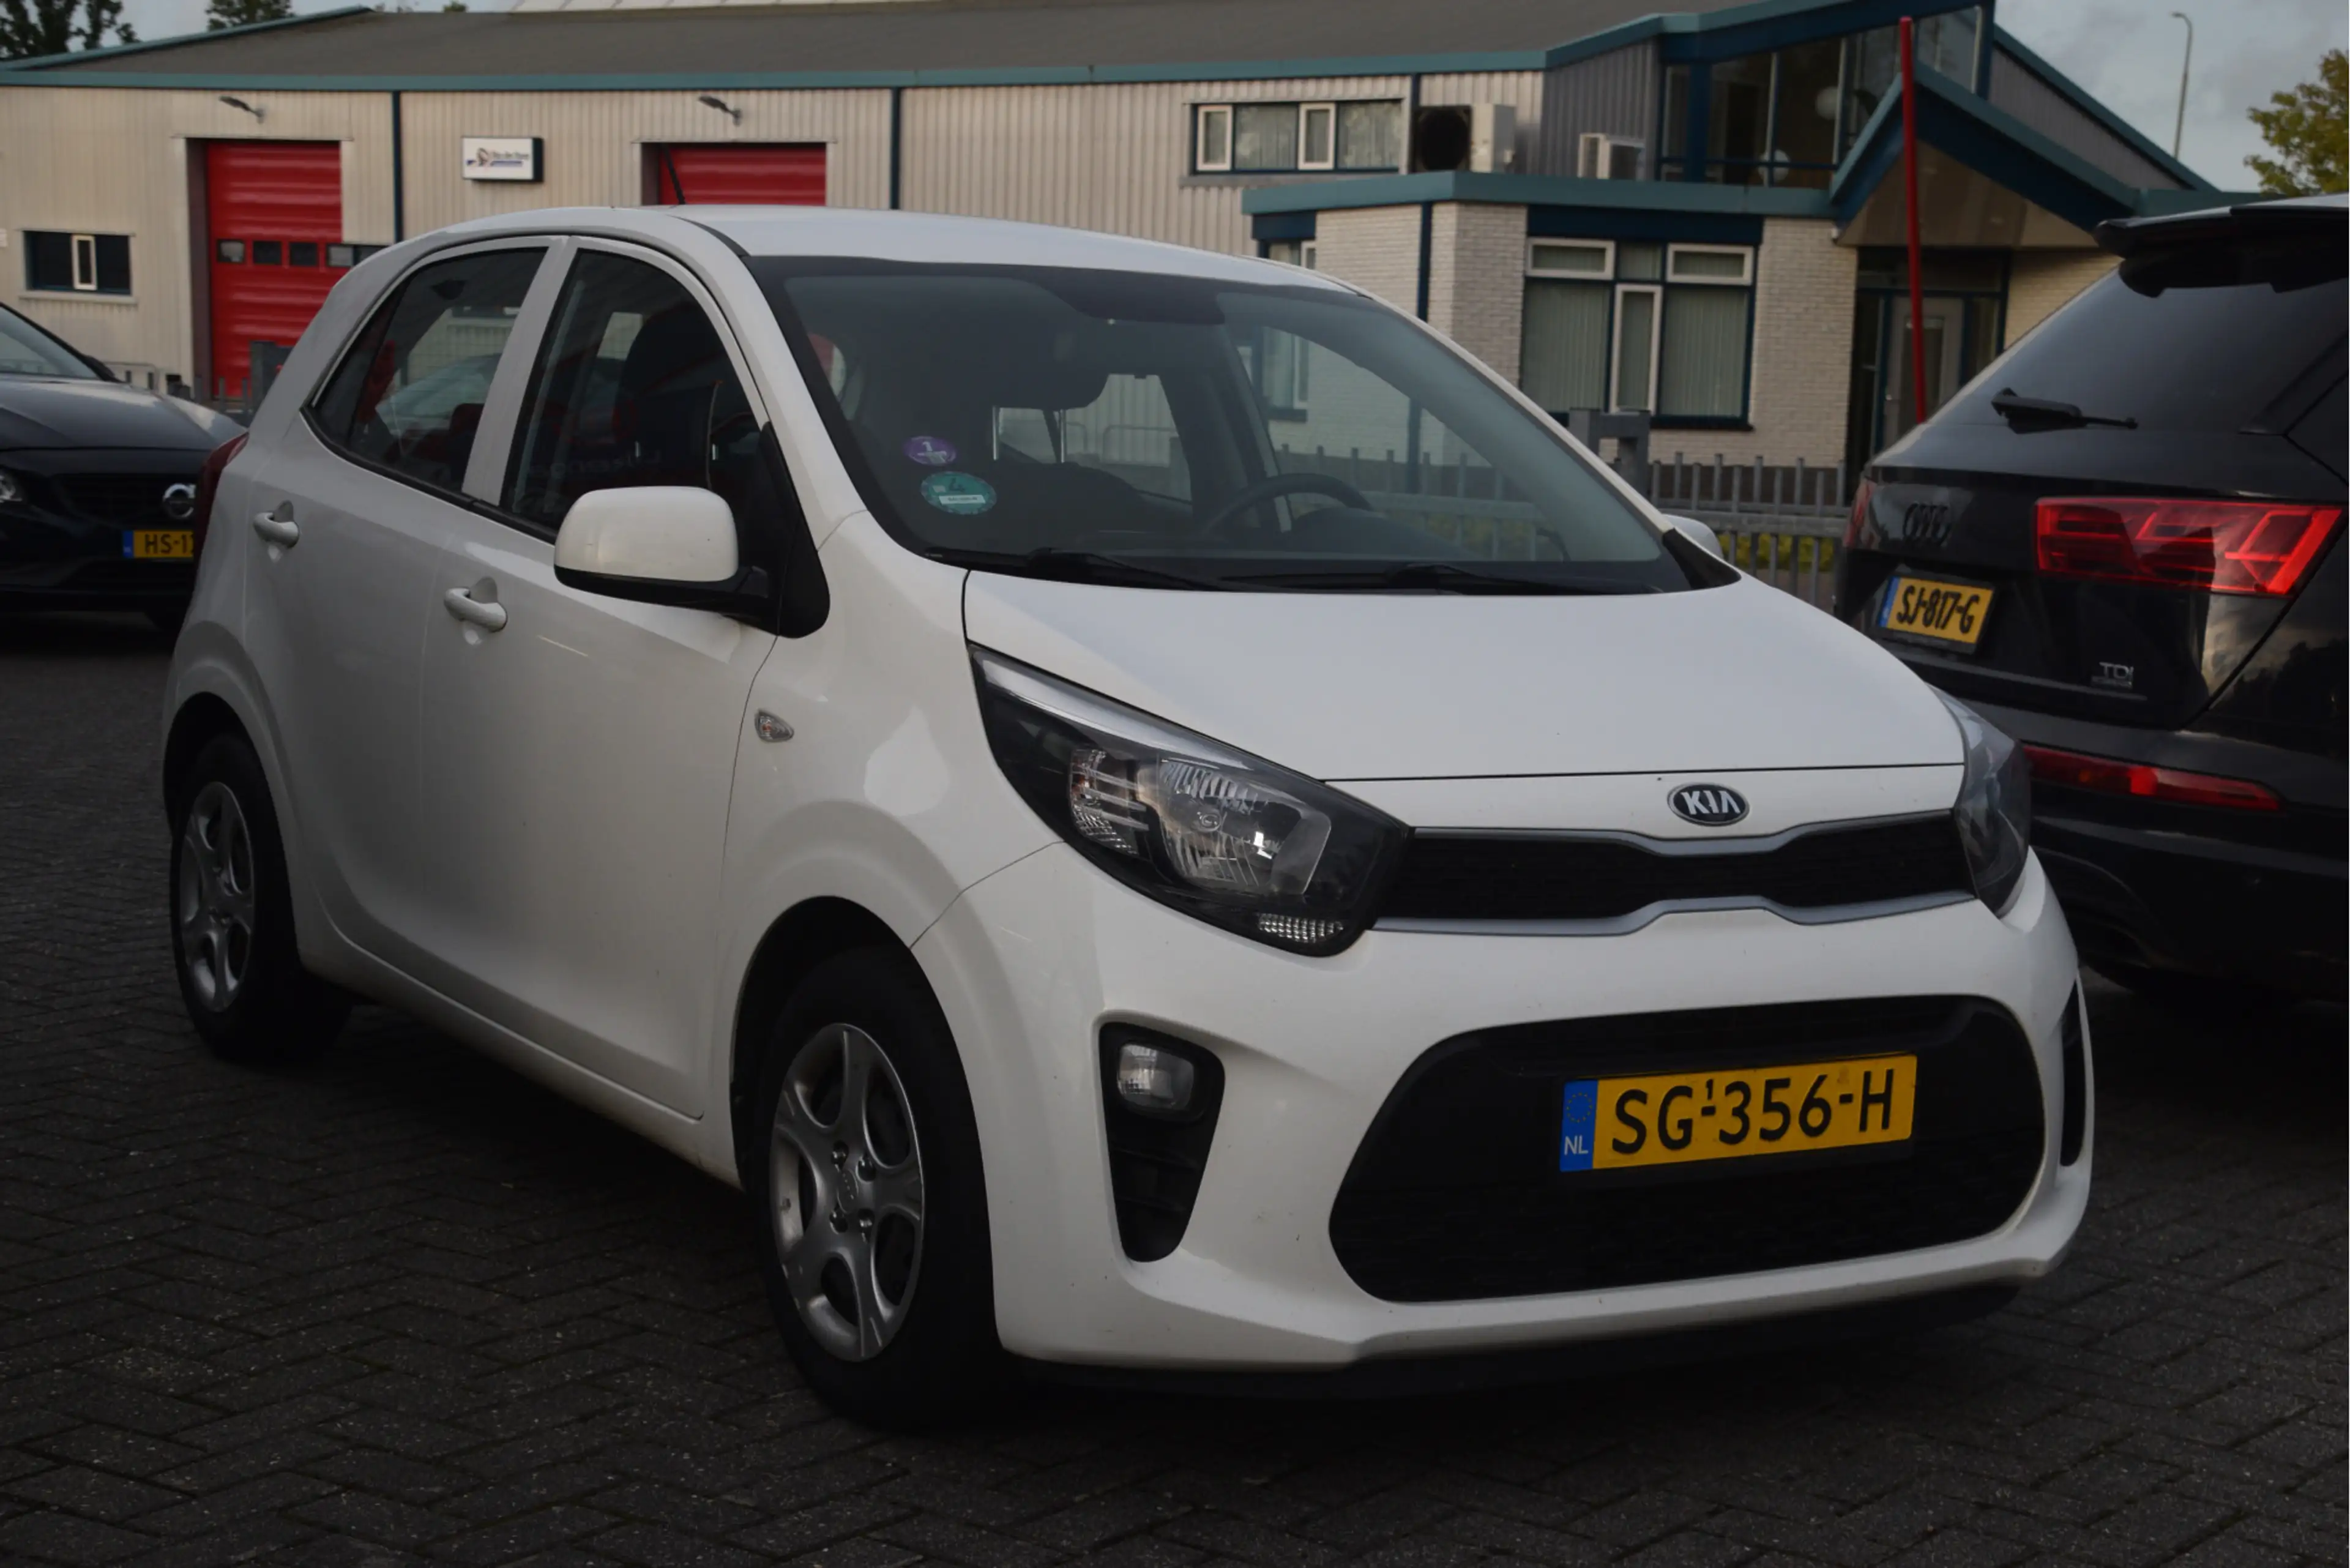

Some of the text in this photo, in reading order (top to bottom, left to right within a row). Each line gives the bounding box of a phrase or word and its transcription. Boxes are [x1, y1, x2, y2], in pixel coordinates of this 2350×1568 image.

[1897, 584, 1980, 634] SJ-817-G
[2098, 662, 2135, 682] TDI
[1680, 790, 1741, 815] KIA
[1564, 1134, 1589, 1156] NL
